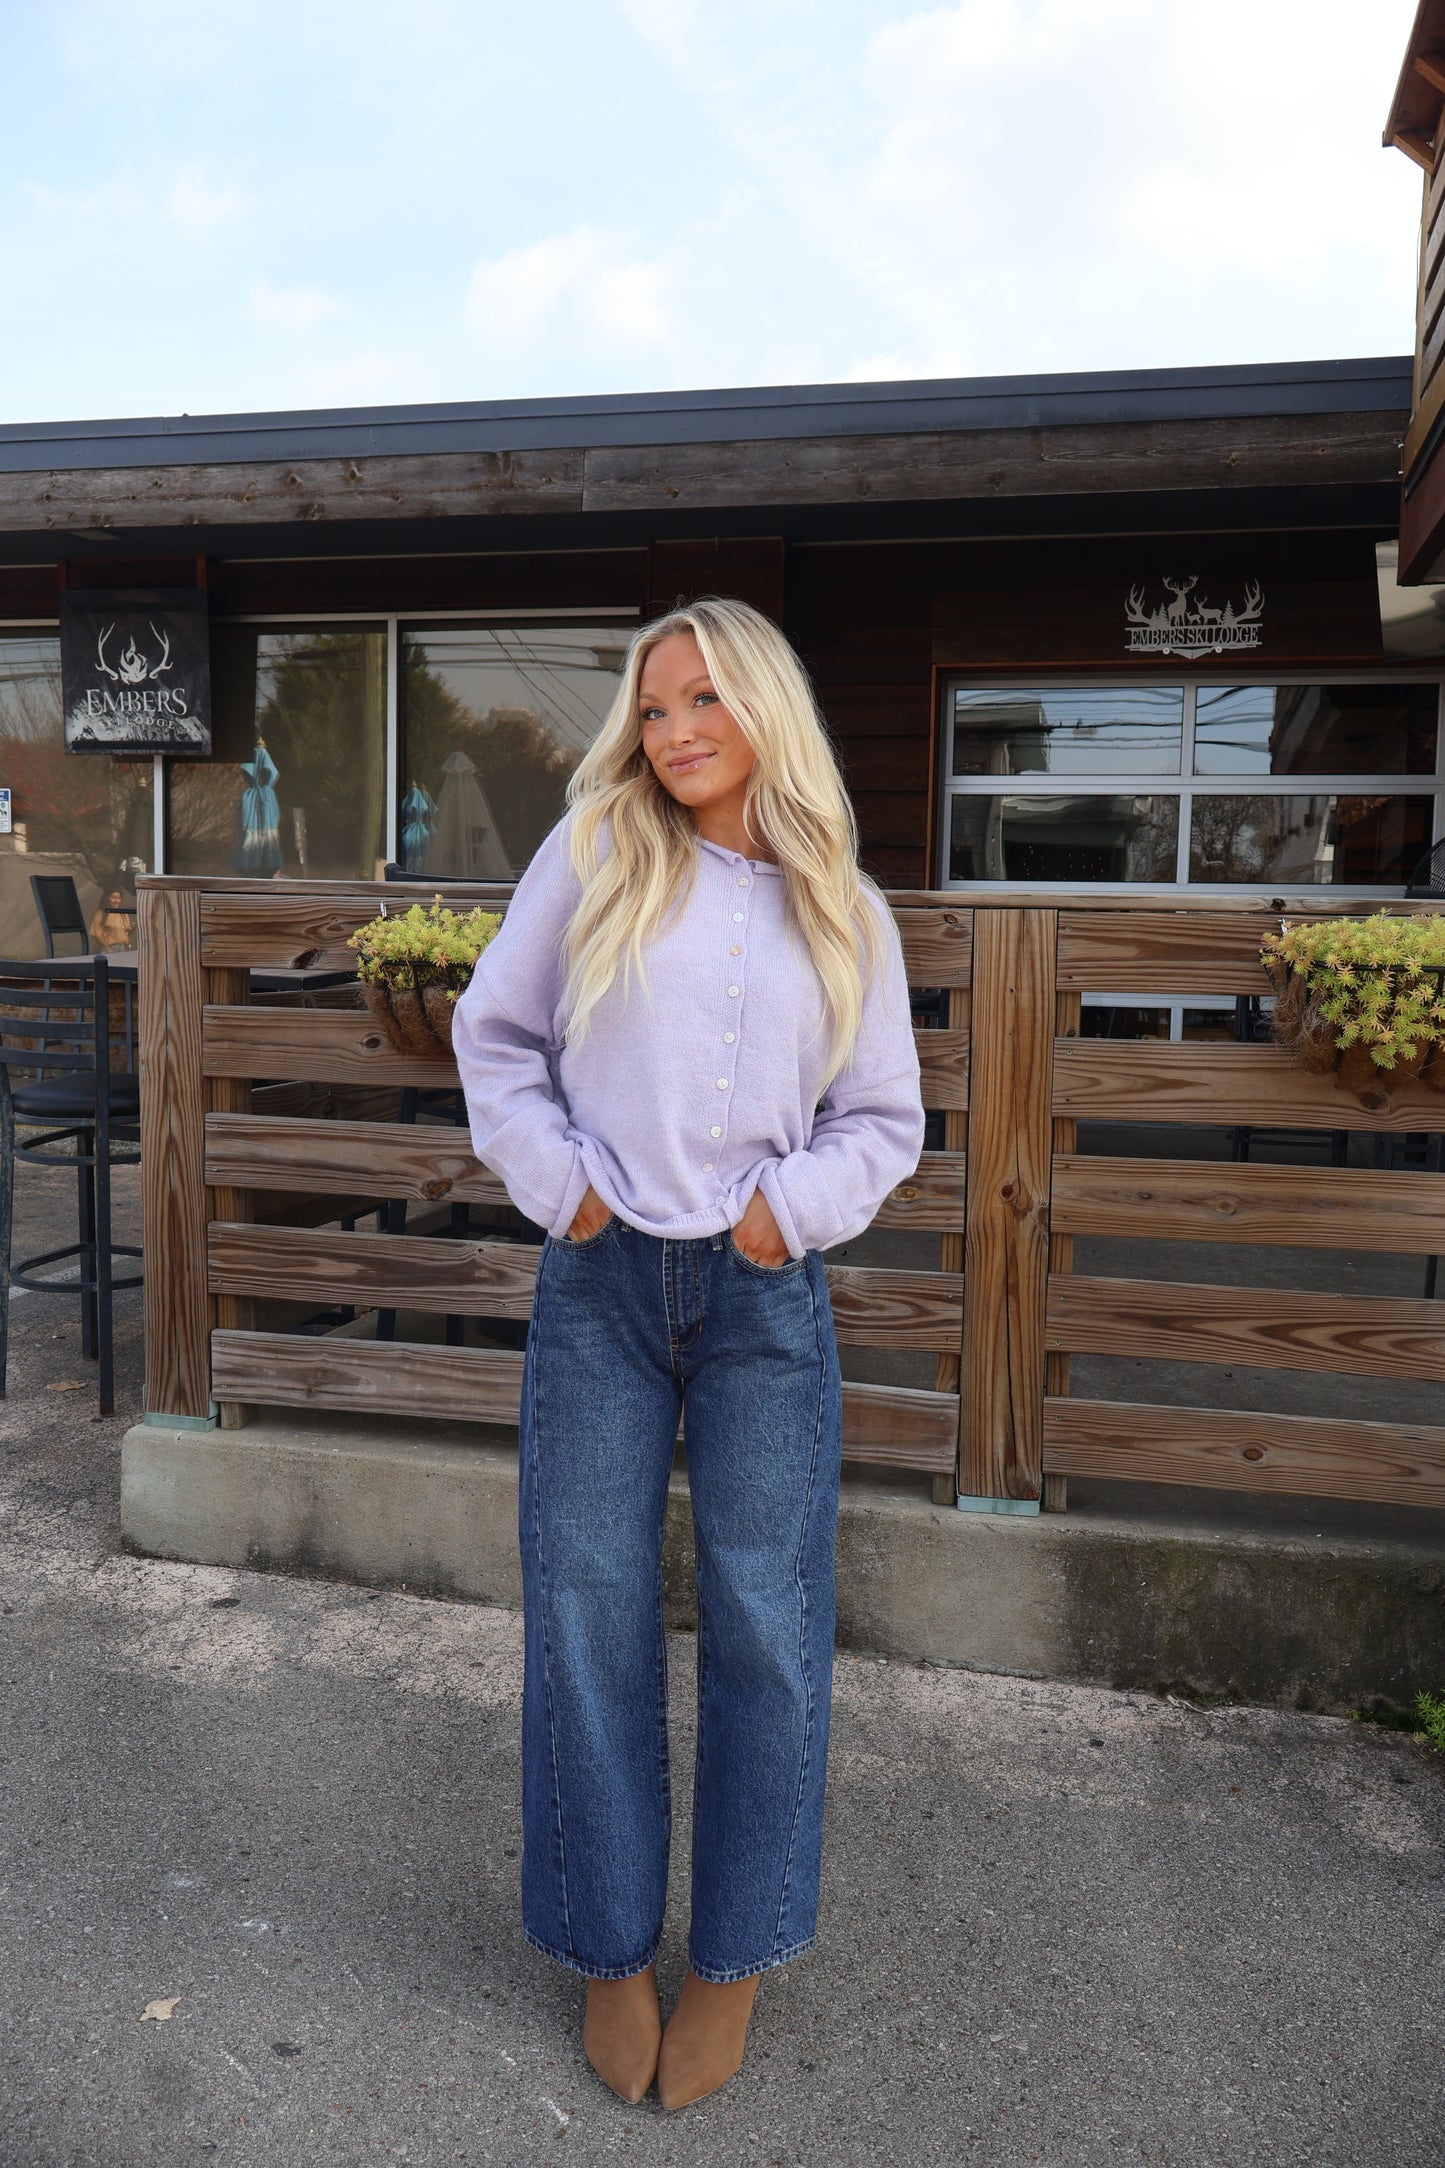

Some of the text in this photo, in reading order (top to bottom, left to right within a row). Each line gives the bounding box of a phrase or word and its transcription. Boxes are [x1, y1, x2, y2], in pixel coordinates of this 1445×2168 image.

[1131, 626, 1259, 645] EMBERS SKI LODGE
[86, 687, 188, 716] EMBERS
[126, 716, 176, 730] LODGE
